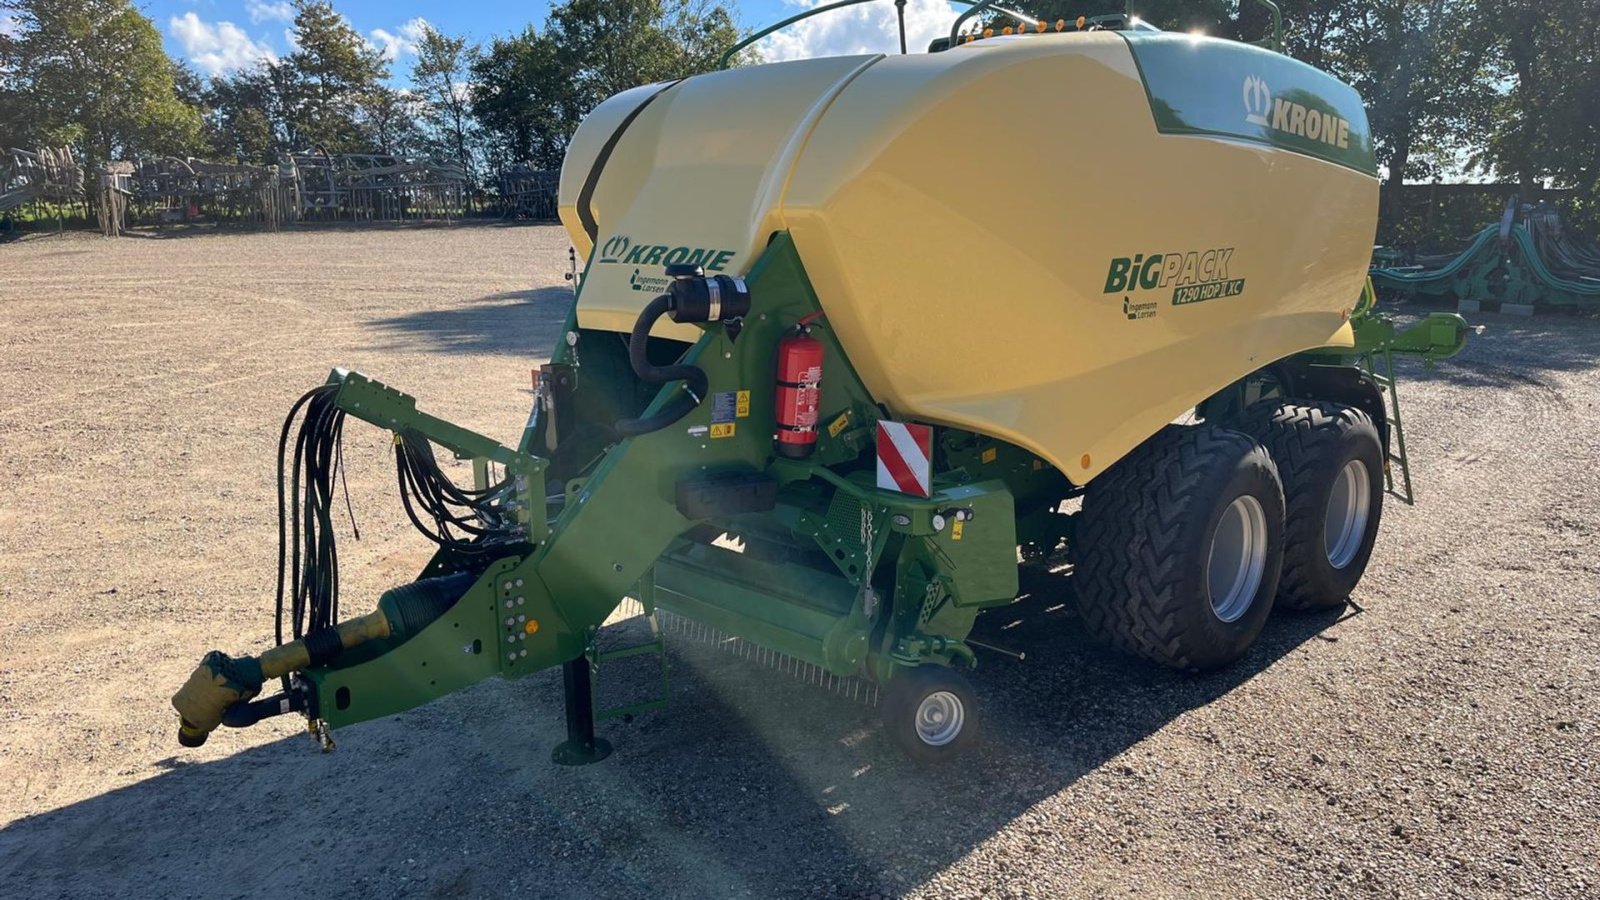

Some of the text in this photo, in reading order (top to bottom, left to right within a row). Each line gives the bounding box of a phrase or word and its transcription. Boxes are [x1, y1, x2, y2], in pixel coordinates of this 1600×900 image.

[1272, 98, 1350, 149] KRONE
[623, 245, 736, 271] KRONE
[637, 274, 669, 286] Ingemann
[642, 285, 665, 293] Larsen
[1176, 285, 1200, 304] 1290
[1229, 280, 1242, 294] XC
[1129, 302, 1158, 313] Ingemann
[1137, 310, 1157, 319] Larsen
